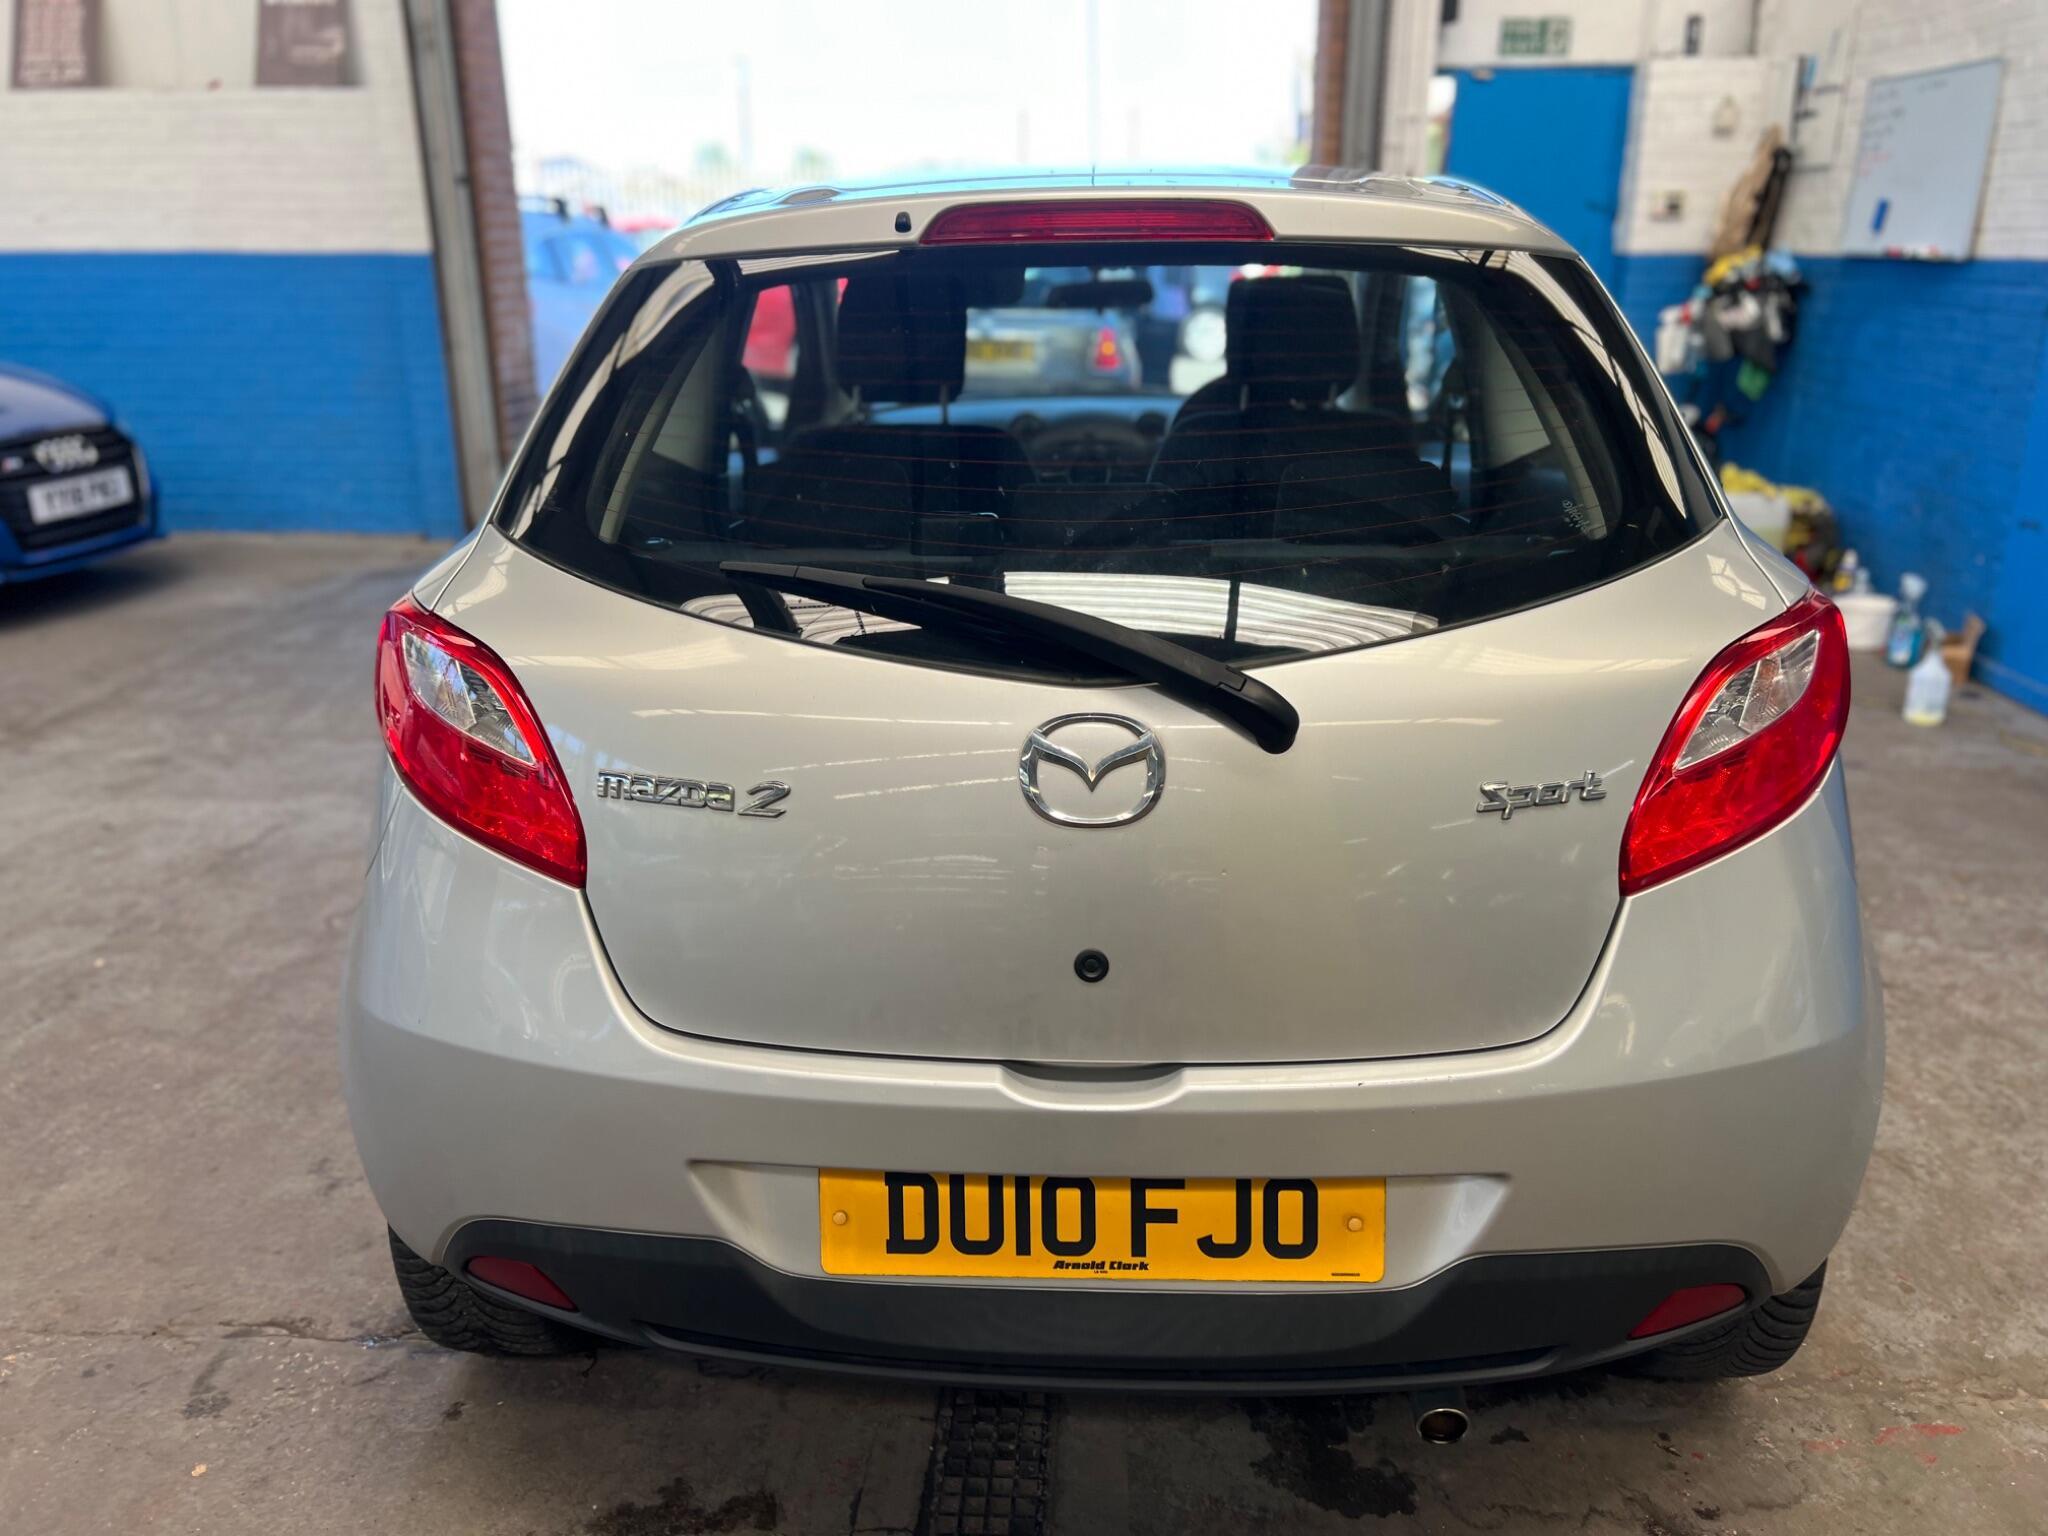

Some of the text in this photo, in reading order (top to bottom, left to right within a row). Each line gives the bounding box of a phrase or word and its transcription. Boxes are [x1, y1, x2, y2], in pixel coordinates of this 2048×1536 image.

[1476, 769, 1607, 820] Sport
[884, 1172, 1319, 1260] DU10 FJO
[1053, 1260, 1150, 1271] Arnold Clark
